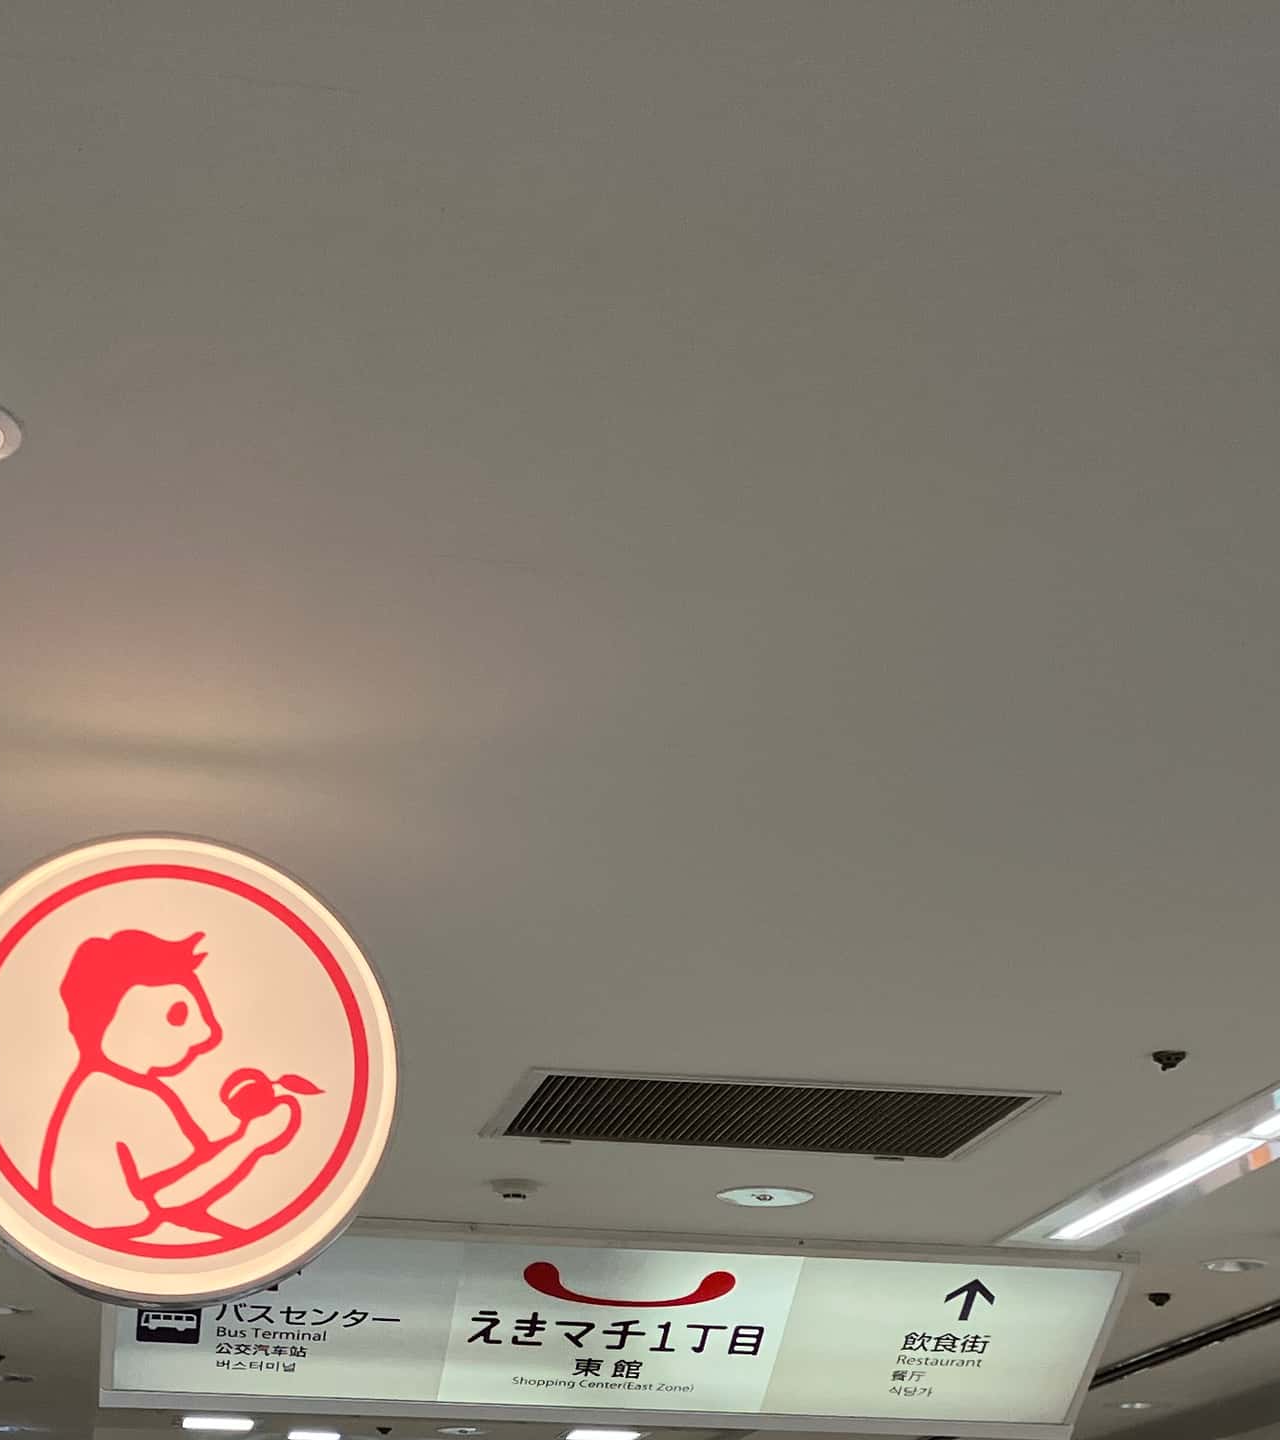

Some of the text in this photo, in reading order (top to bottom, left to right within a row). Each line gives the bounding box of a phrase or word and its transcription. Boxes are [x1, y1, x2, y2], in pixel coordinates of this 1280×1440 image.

[215, 1303, 401, 1328] バスセンター
[216, 1326, 327, 1342] Bus Terminal
[467, 1310, 765, 1356] えきマチ1丁目
[215, 1343, 307, 1358] 公交汽车站
[901, 1332, 991, 1354] 飲食街
[216, 1360, 296, 1373] 버스터미널
[572, 1357, 643, 1380] 東館
[896, 1354, 983, 1368] Restaurant
[512, 1376, 575, 1390] Shopping
[657, 1383, 695, 1393] Zone)
